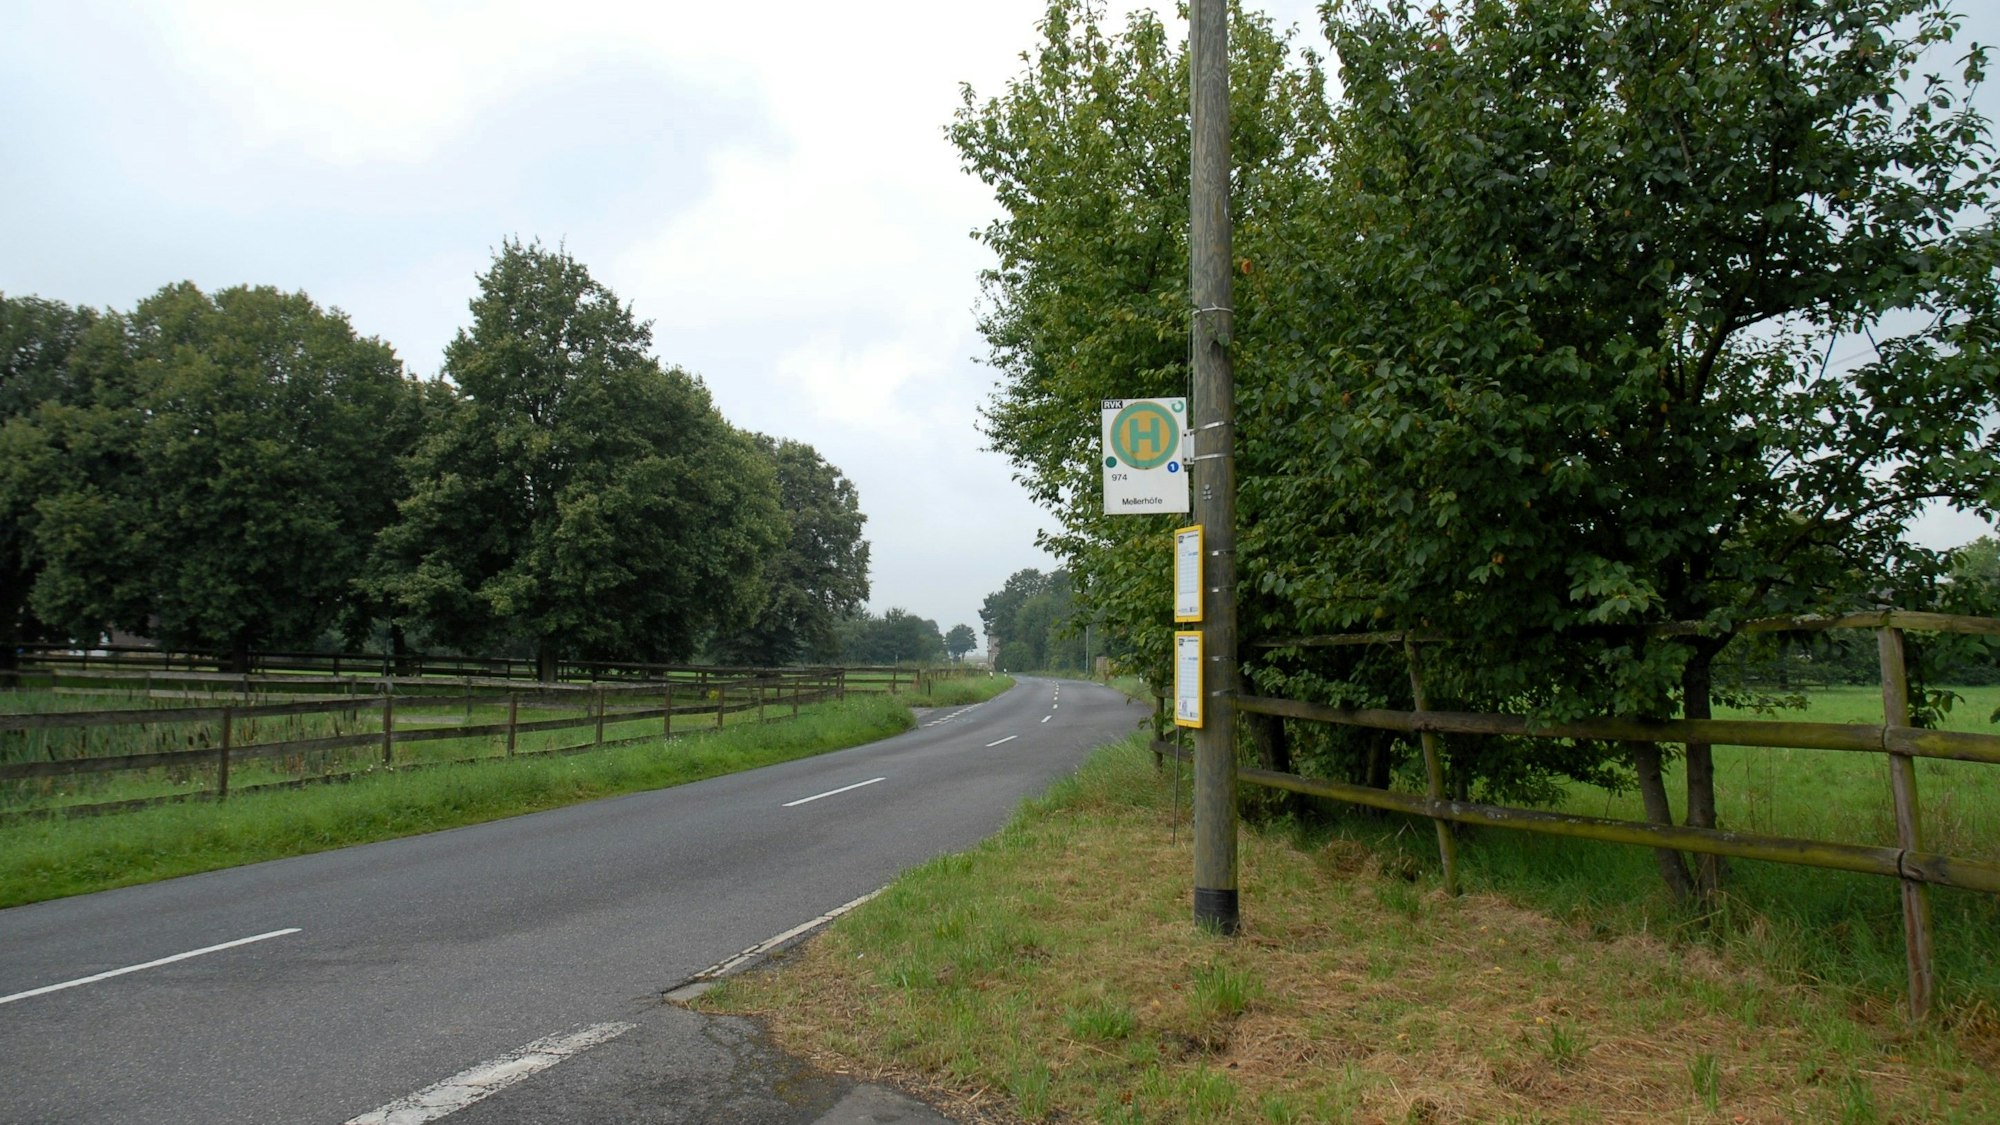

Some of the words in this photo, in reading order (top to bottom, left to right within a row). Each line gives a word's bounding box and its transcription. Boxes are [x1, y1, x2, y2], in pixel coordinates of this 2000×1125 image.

[1104, 401, 1122, 409] RVK
[1130, 417, 1160, 453] H
[1170, 463, 1175, 471] 1
[1111, 473, 1128, 481] 974
[1122, 497, 1163, 505] Mellerhöfe
